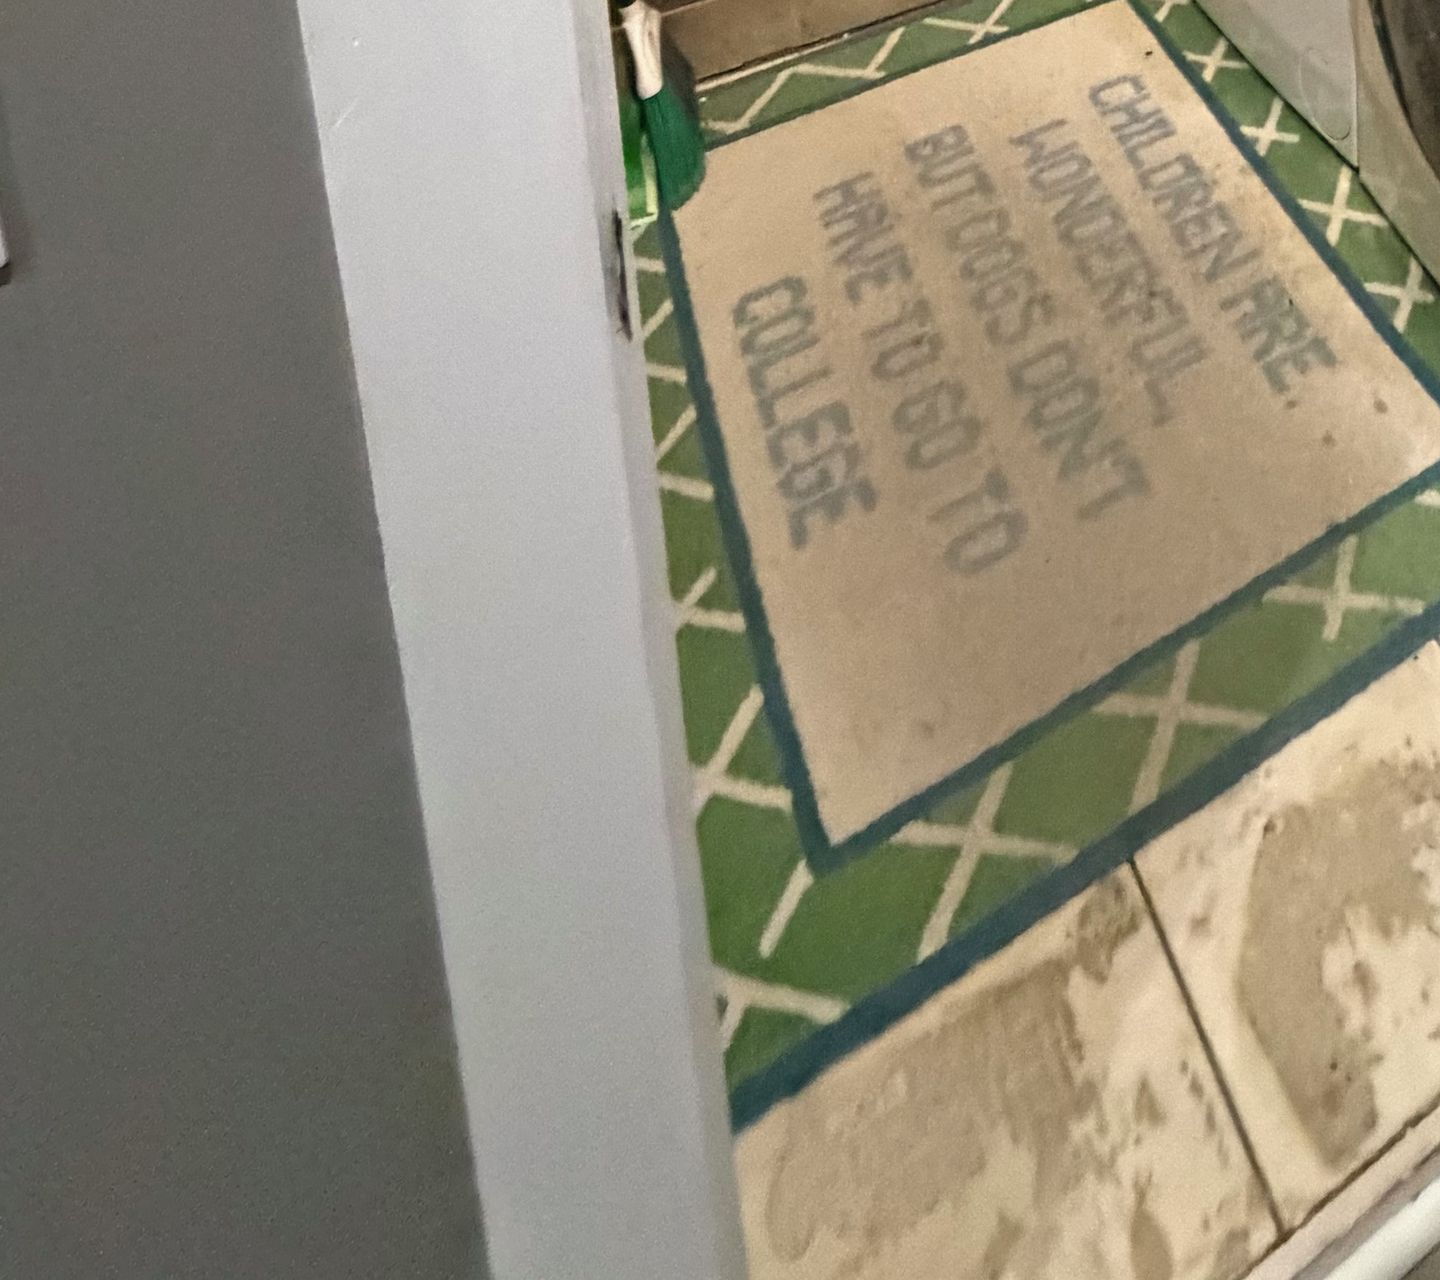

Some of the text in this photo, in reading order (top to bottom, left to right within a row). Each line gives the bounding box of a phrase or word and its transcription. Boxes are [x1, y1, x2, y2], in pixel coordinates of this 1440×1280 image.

[905, 124, 996, 214] BUT
[944, 209, 1055, 346] DOGS
[1089, 74, 1339, 395] CHILDREN ARE
[732, 275, 878, 550] COLLEGE
[812, 171, 1029, 575] HAVE TO GO TO
